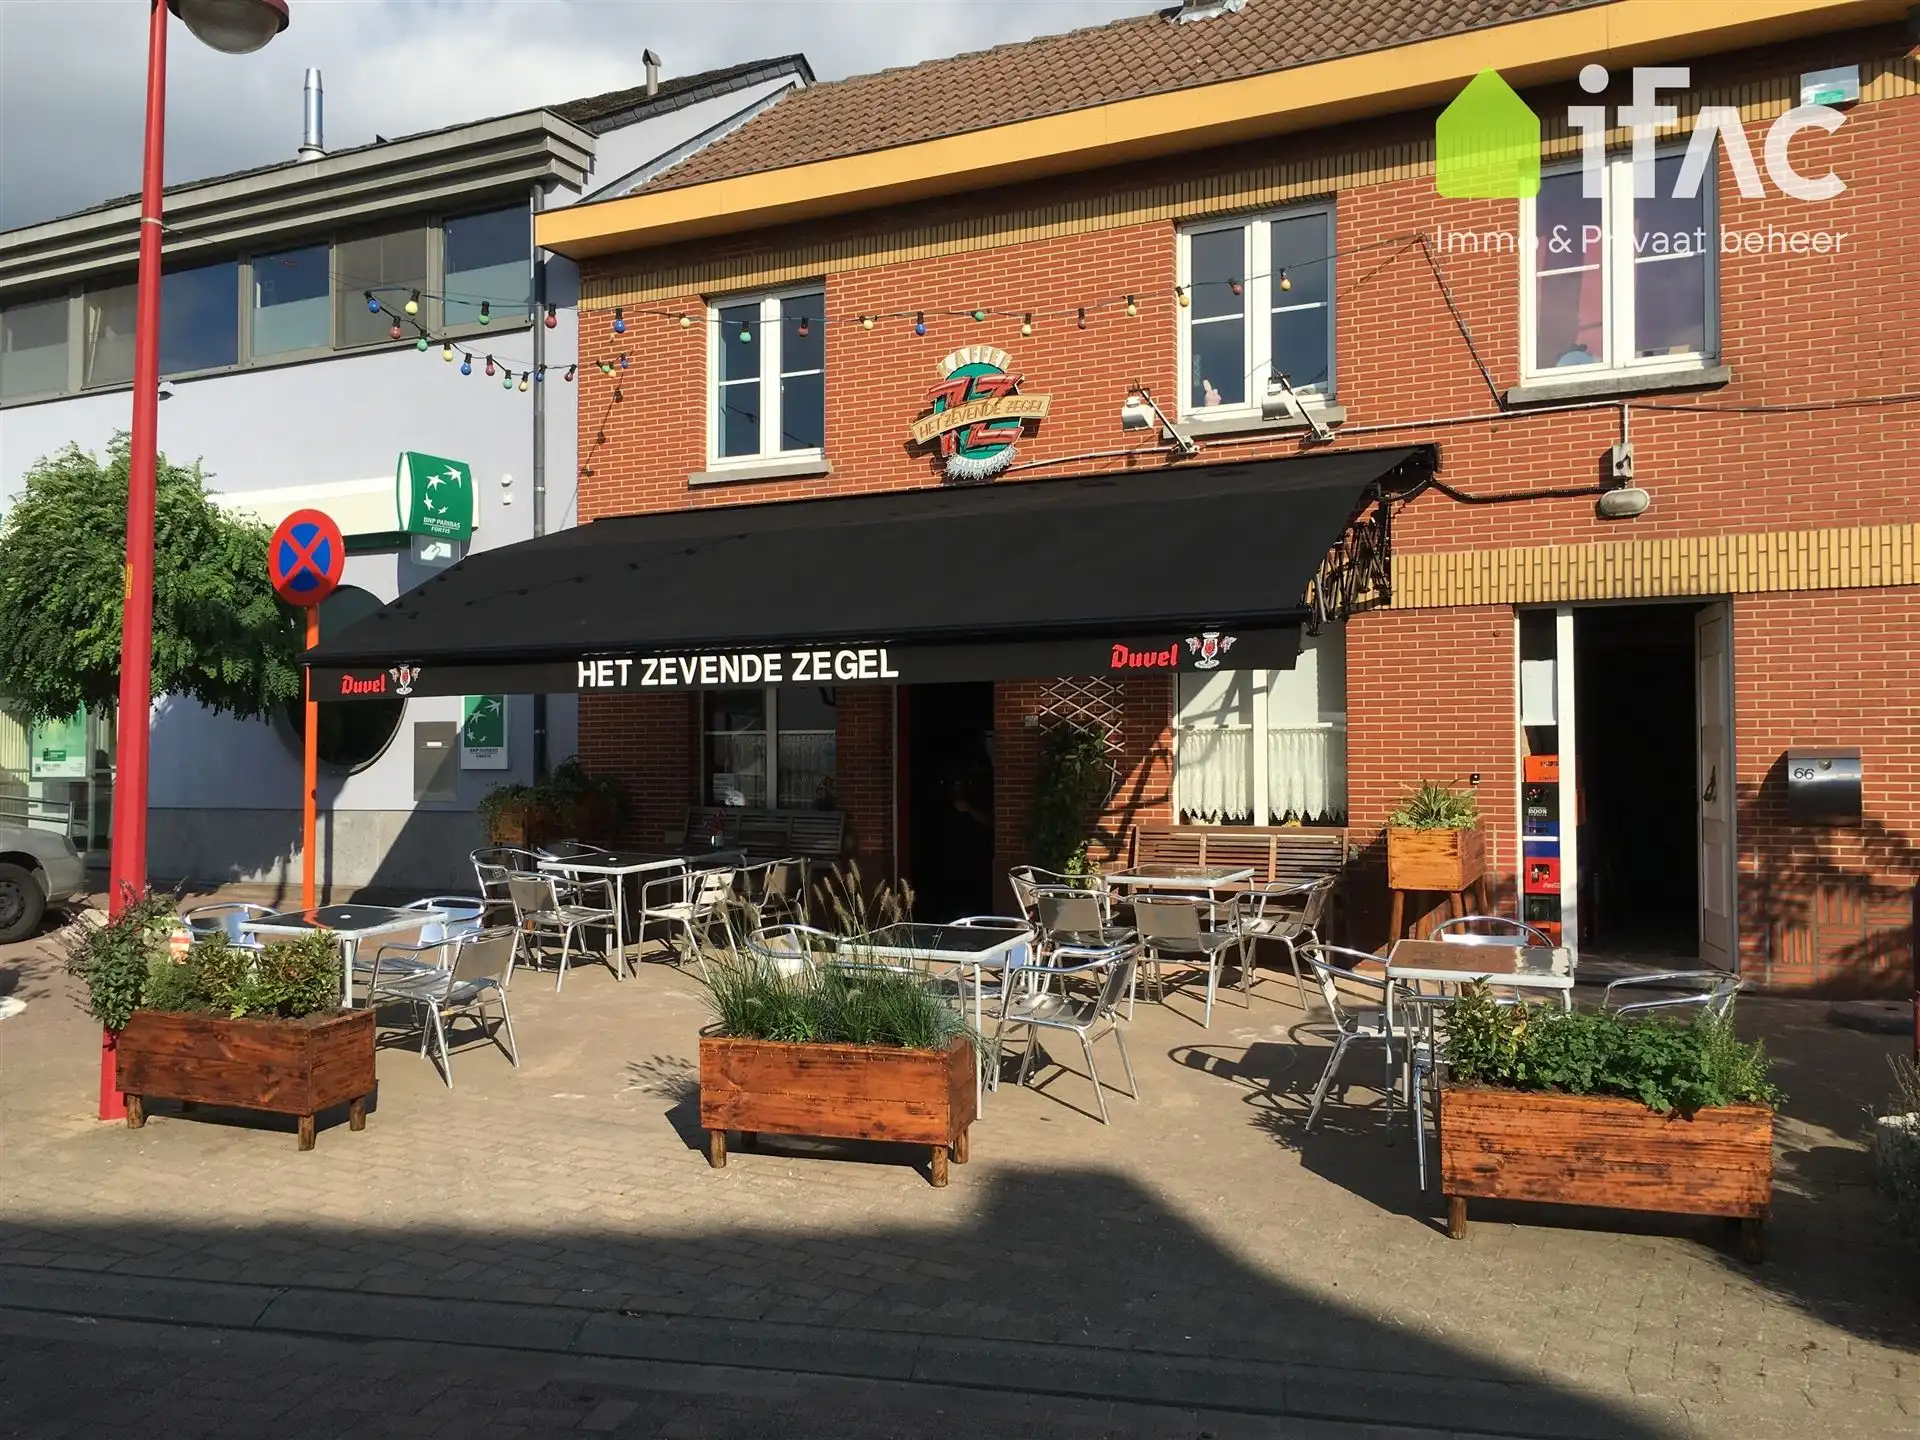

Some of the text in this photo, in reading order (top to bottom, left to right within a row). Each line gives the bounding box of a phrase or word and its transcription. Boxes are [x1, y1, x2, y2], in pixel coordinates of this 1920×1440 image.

[919, 399, 1044, 439] HET ZEVENDE ZEGEL
[577, 648, 899, 687] HET ZEVENDE ZEGEL
[1111, 643, 1179, 668] Duvel
[341, 674, 386, 694] Duvel
[1793, 767, 1815, 780] 66
